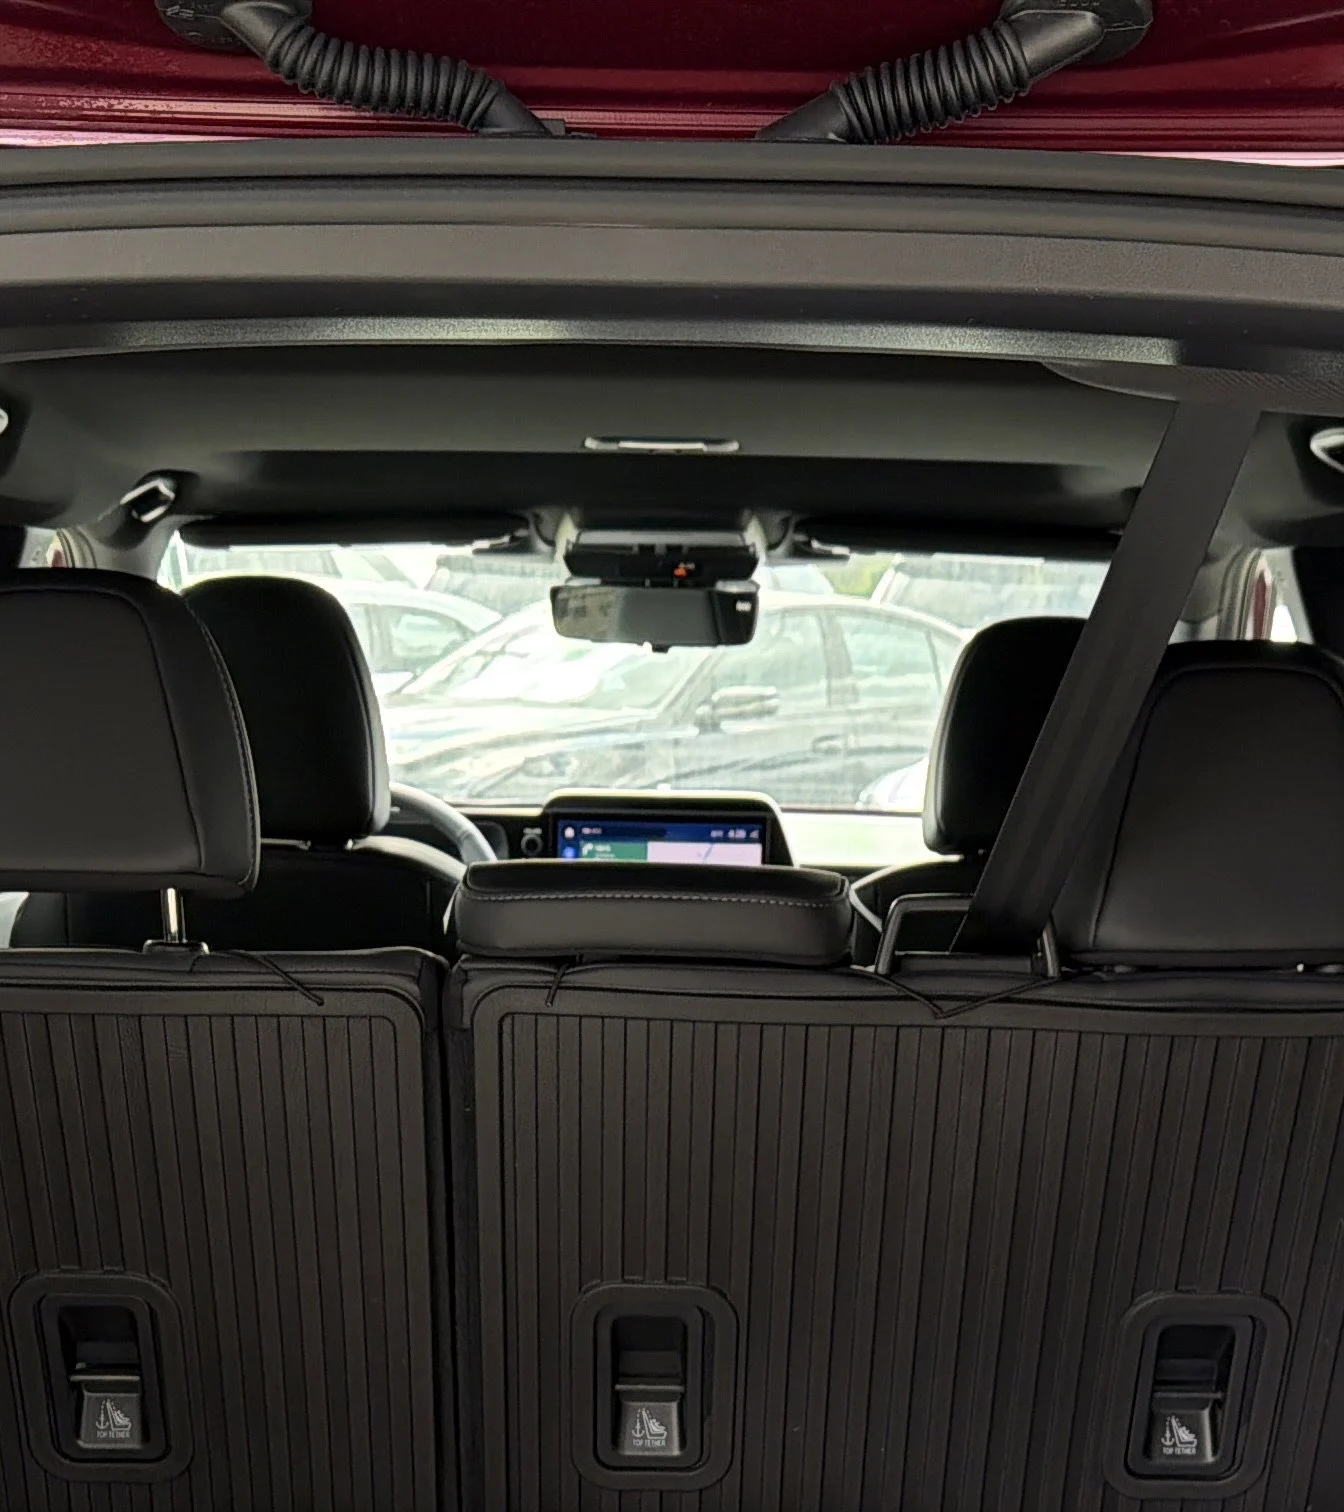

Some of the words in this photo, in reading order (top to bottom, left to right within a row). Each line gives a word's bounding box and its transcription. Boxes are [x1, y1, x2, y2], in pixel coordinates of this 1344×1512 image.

[96, 1430, 108, 1438] TOP
[632, 1439, 643, 1447] TOP
[1163, 1447, 1173, 1455] TOP
[1174, 1447, 1197, 1455] TETHER
